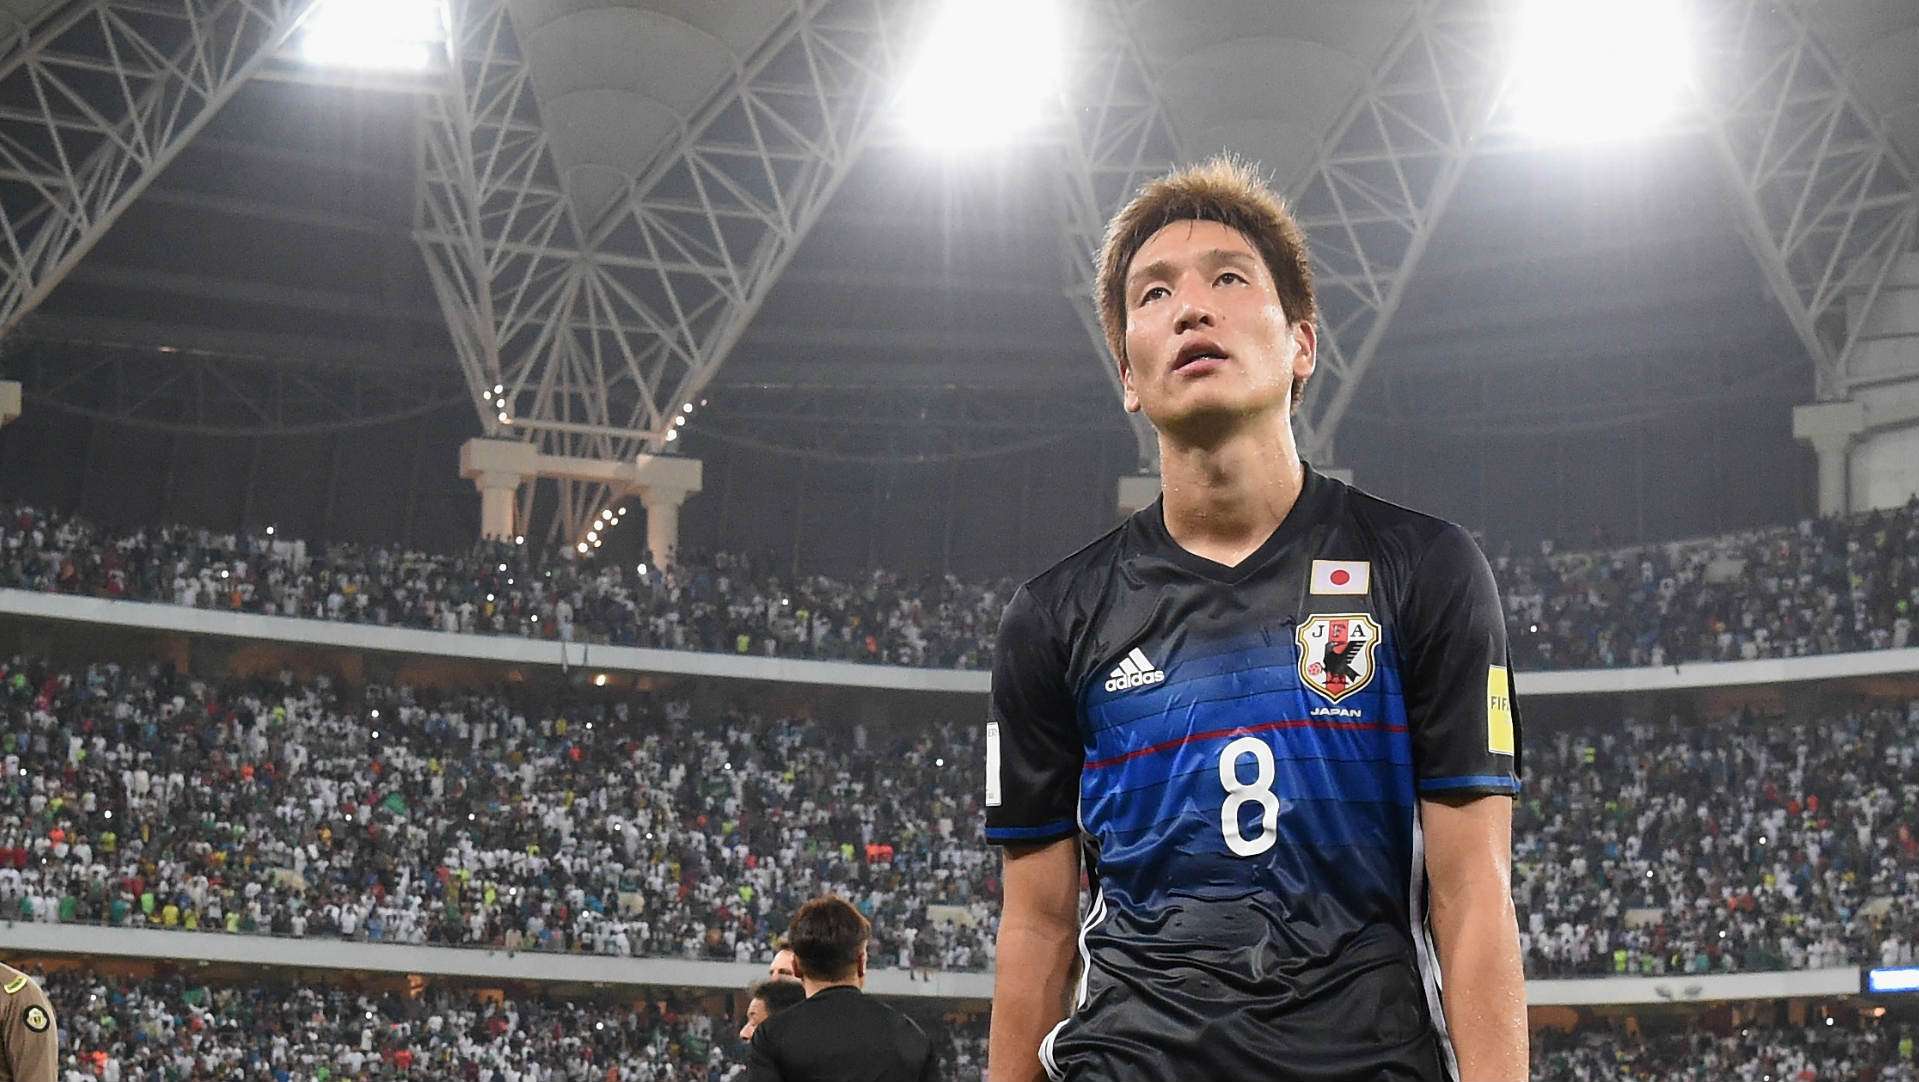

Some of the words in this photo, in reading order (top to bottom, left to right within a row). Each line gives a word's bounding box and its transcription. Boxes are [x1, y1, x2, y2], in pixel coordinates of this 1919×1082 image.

[1105, 669, 1165, 692] adidas
[1310, 707, 1361, 717] JAPAN
[1491, 696, 1509, 710] FIF
[1219, 737, 1279, 857] 8
